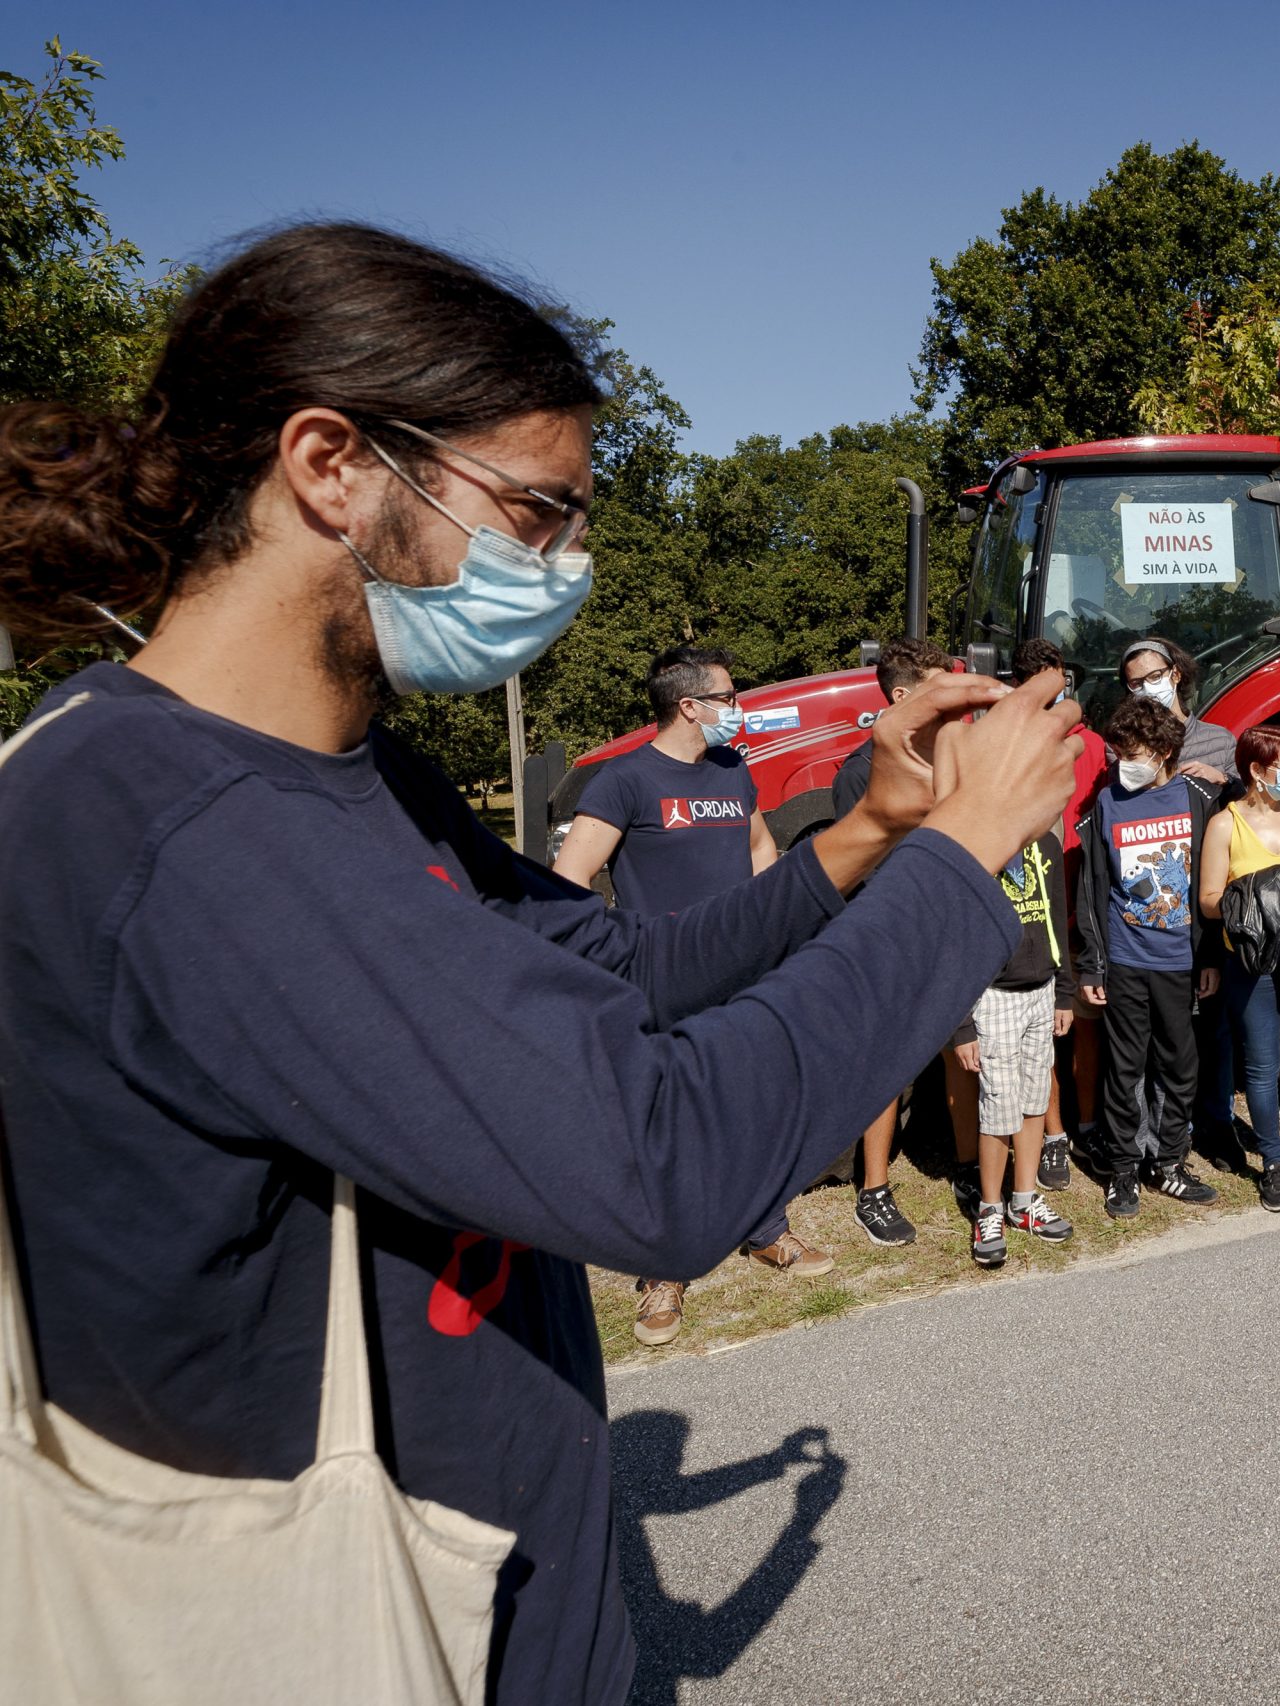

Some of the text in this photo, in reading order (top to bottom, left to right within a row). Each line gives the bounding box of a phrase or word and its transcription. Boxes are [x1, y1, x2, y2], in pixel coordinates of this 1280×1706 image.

[1149, 508, 1206, 524] NÃO ÀS
[1145, 535, 1213, 552] MINAS
[1143, 561, 1218, 575] SIM À VIDA
[689, 800, 744, 821] JORDAN
[1121, 818, 1191, 843] MONSTER
